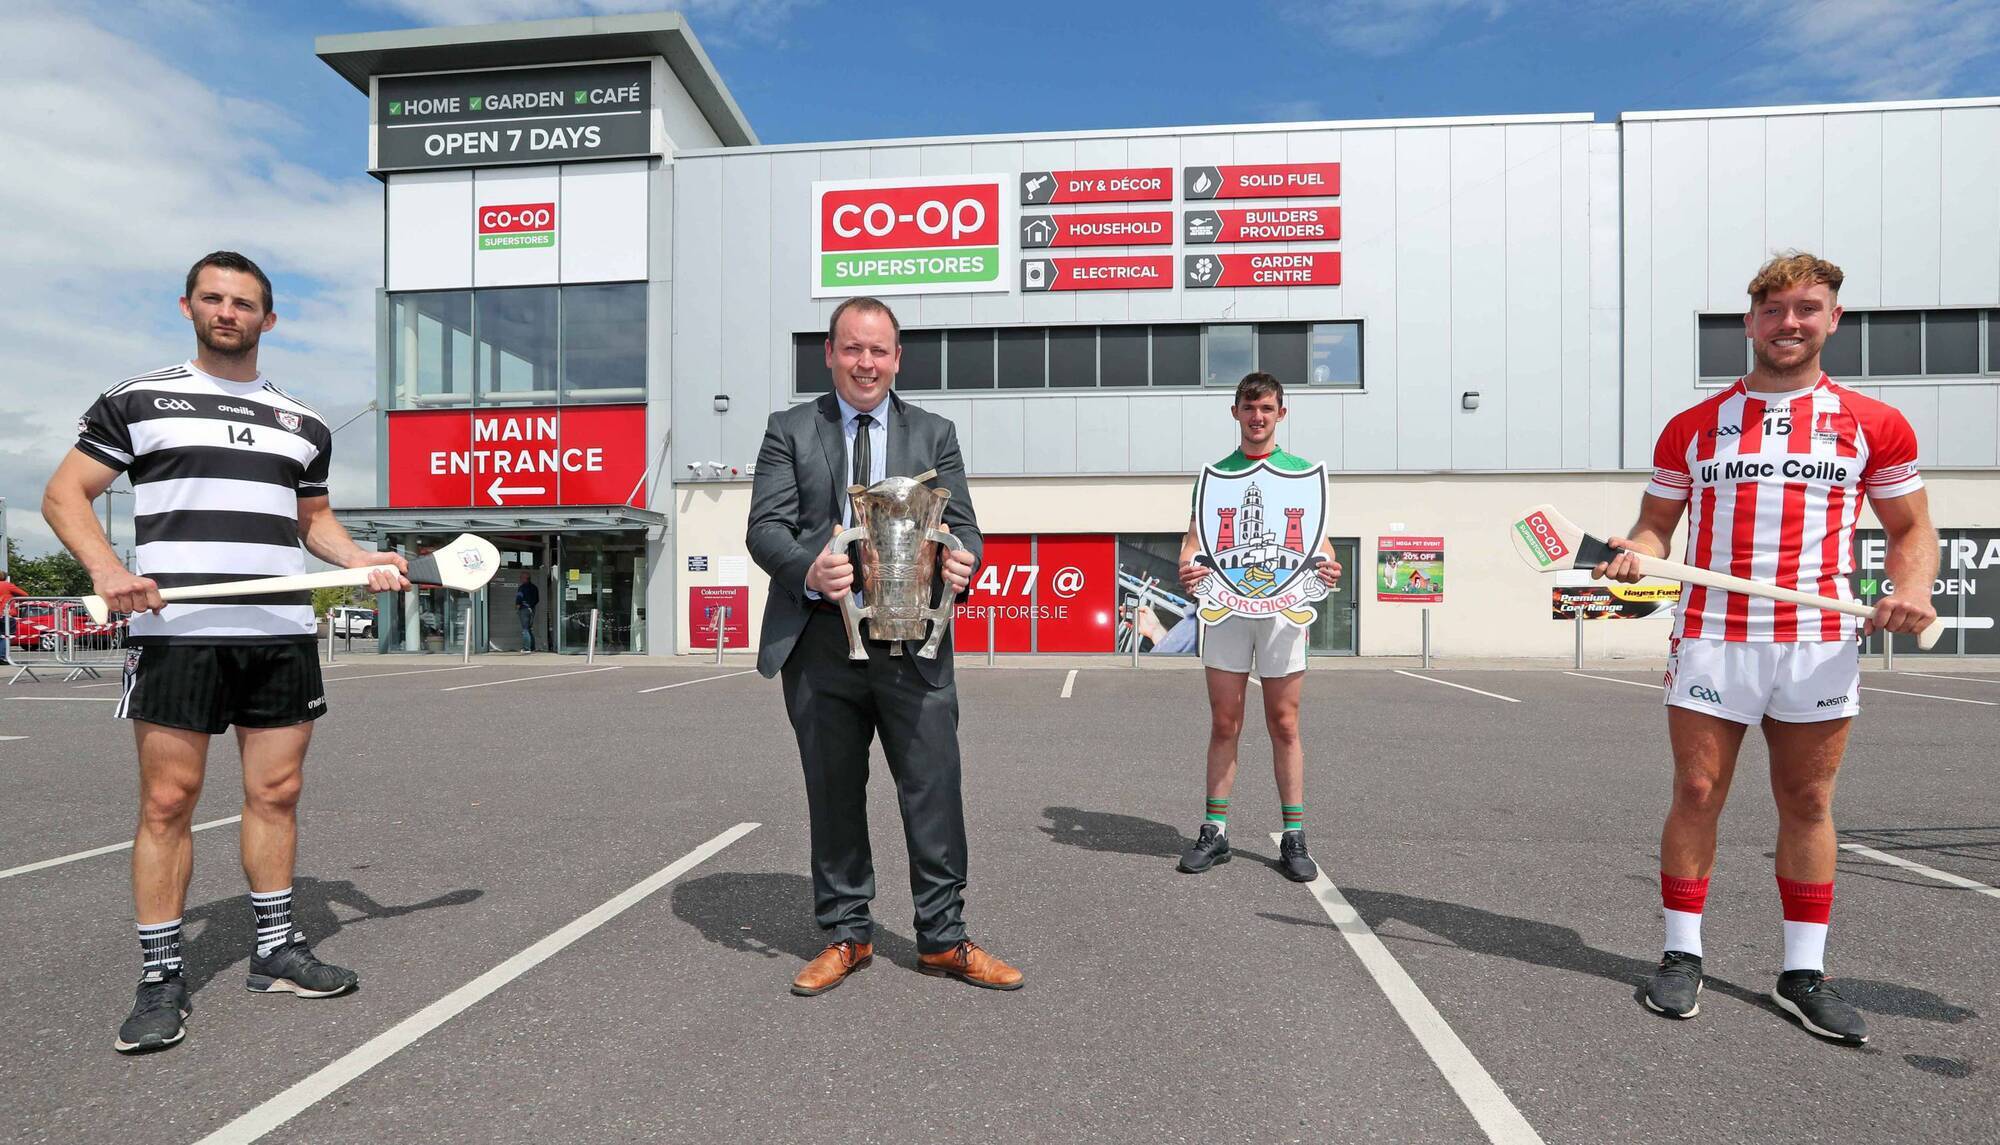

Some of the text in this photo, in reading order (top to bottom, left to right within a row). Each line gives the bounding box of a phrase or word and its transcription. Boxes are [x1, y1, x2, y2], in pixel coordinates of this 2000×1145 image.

[404, 82, 640, 115] HOME GARDEN CAFÉ
[424, 126, 601, 156] OPEN 7 DAYS
[1069, 176, 1161, 193] DIY & DÉCOR
[1239, 172, 1325, 187] SOLID FUEL
[1245, 210, 1318, 224] BUILDERS
[1069, 220, 1162, 236] HOUSEHOLD
[1240, 223, 1325, 238] PROVIDERS
[484, 235, 549, 247] SUPERSTORES
[835, 255, 985, 279] SUPERSTORES
[1250, 256, 1314, 269] GARDEN
[1072, 265, 1159, 280] ELECTRICAL
[1253, 268, 1312, 283] CENTRE
[474, 417, 557, 442] MAIN
[1763, 417, 1793, 436] 15
[228, 425, 255, 446] 14
[431, 448, 603, 475] ENTRANCE
[1701, 460, 1847, 482] Uí Mac Coille
[969, 564, 1084, 598] 4/7 @
[1881, 579, 1976, 595] GDEN
[1561, 594, 1610, 602] Premium
[1587, 604, 1624, 612] Range
